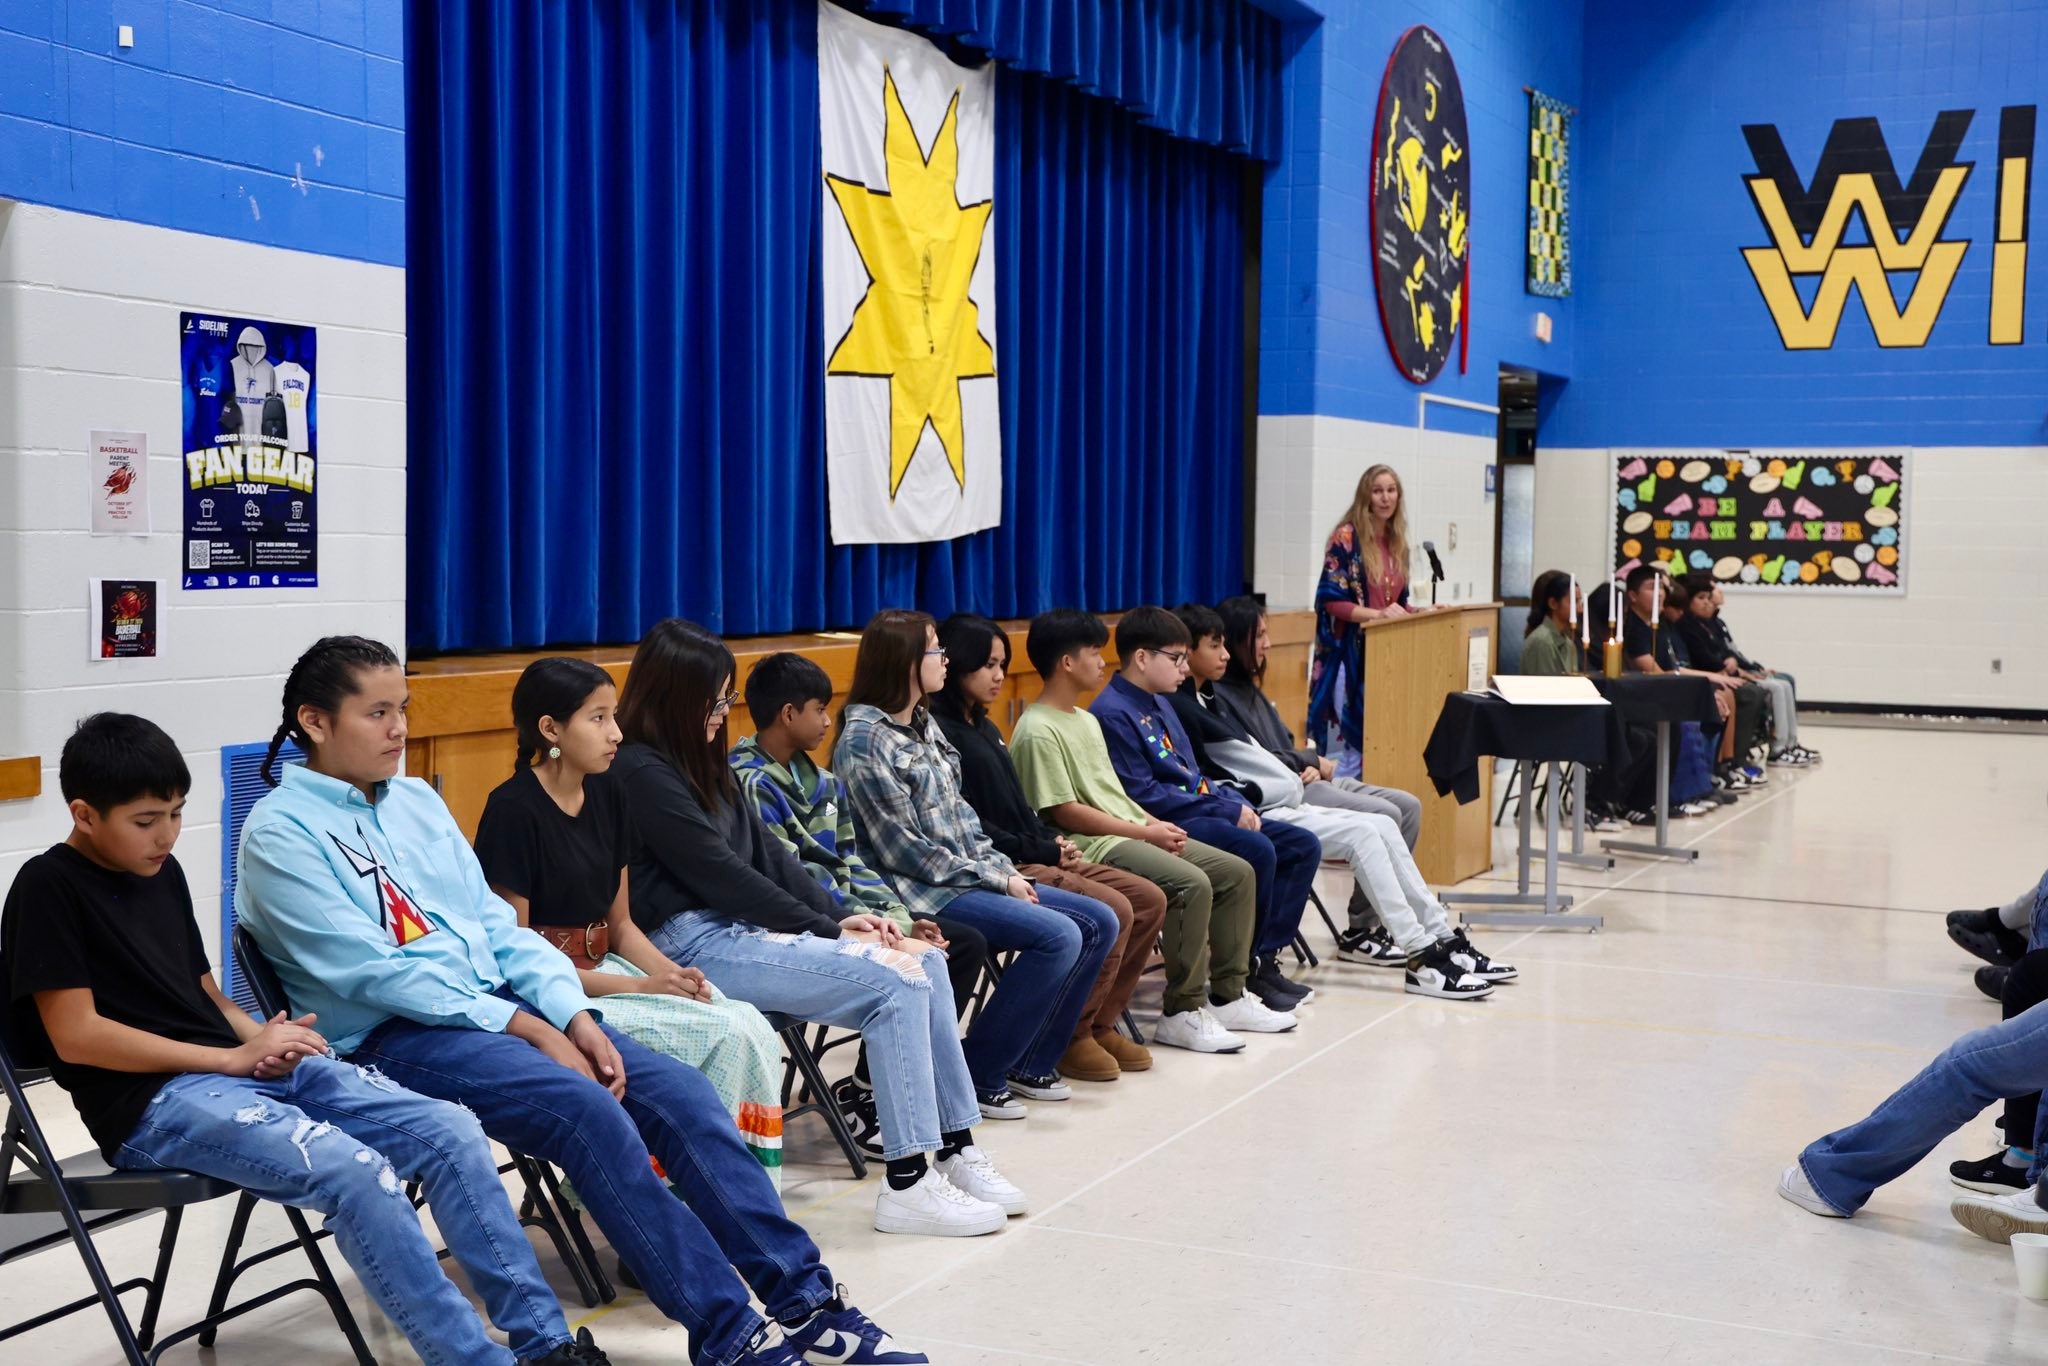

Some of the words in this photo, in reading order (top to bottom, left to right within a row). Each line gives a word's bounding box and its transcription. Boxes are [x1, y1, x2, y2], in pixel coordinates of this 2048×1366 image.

[199, 319, 229, 332] SIDELINE
[209, 330, 228, 338] STORE
[287, 391, 300, 409] 18
[214, 433, 239, 444] ORDER
[239, 433, 259, 442] YOUR
[259, 434, 289, 447] FALCONS
[99, 446, 139, 454] BASKETBALL
[186, 445, 244, 490] FAN
[246, 446, 315, 494] GEAR
[236, 483, 269, 495] TODAY
[1697, 497, 1737, 517] BE
[1763, 497, 1786, 518] A
[1653, 519, 1737, 541] TEAM
[1749, 520, 1863, 541] PLAYER
